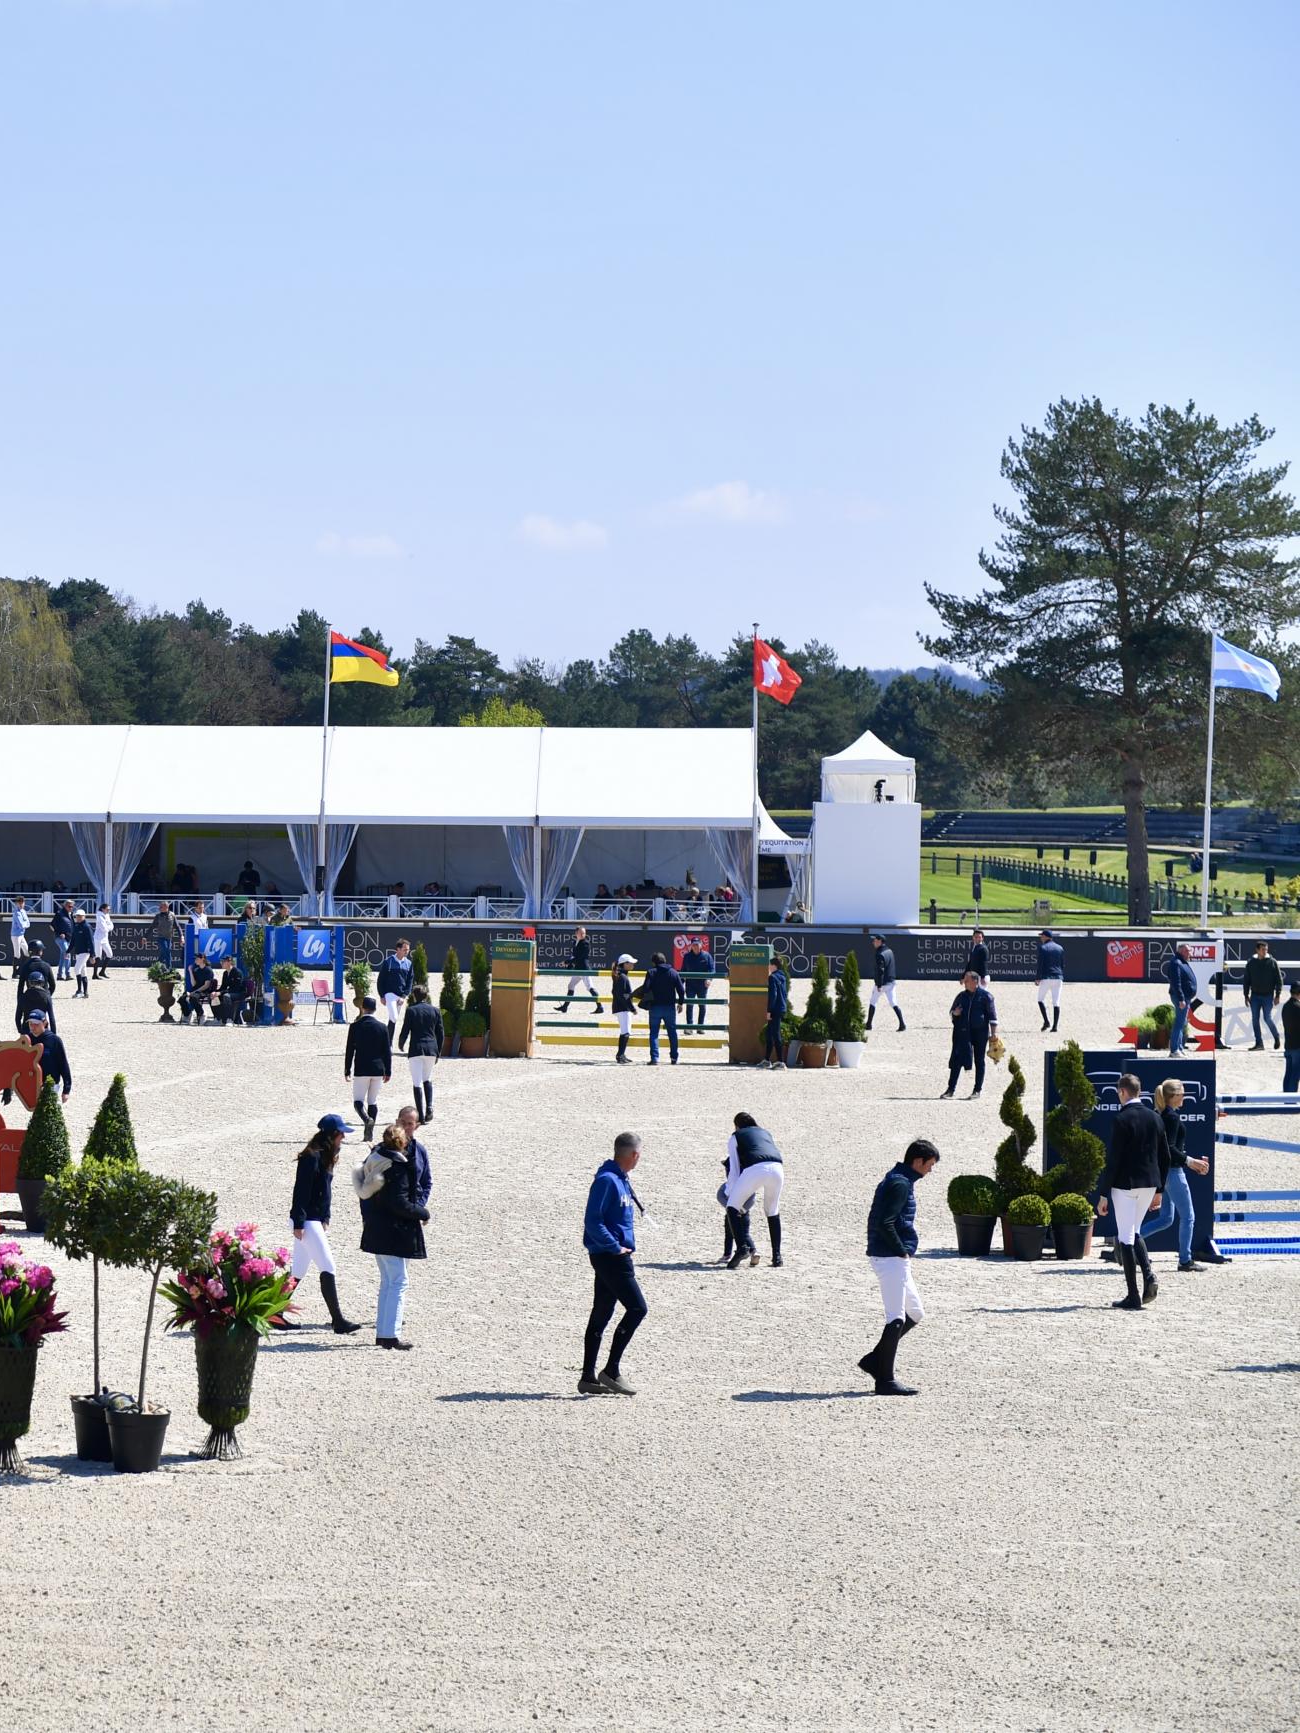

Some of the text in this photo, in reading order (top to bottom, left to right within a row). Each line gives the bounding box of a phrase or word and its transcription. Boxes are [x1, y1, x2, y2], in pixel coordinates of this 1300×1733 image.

[917, 940, 930, 949] LE
[1013, 941, 1038, 950] DES
[1107, 941, 1128, 956] GL
[917, 953, 964, 962] SPORTS
[1114, 943, 1145, 965] events
